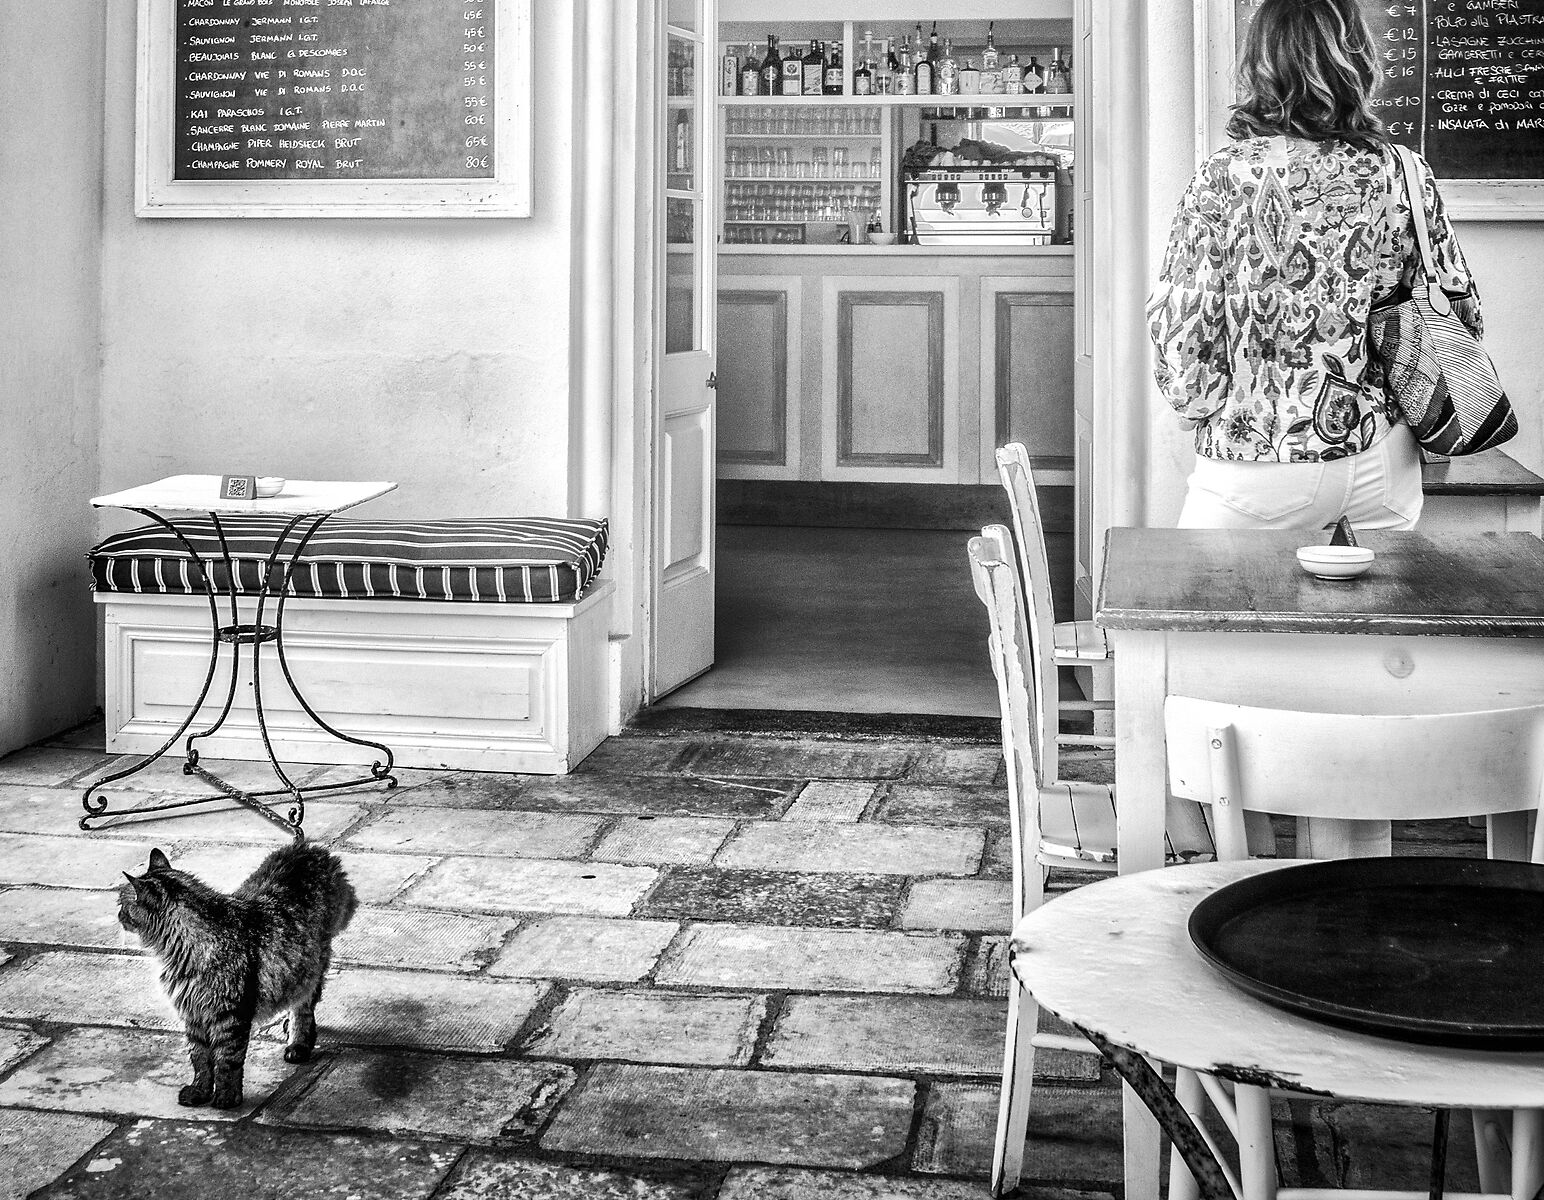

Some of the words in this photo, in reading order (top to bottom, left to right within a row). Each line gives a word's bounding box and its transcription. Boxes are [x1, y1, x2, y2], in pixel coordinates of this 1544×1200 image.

[1466, 0, 1519, 10] GAMBERI
[188, 18, 240, 26] CHARDONNAY
[252, 16, 292, 26] JERMANN
[1435, 15, 1467, 28] POLPO
[1470, 15, 1490, 28] alla
[189, 36, 236, 46] SAUVIGNON
[250, 33, 293, 44] JERMANN
[1436, 36, 1490, 48] LASAGNE
[251, 51, 278, 61] BLANC
[1438, 48, 1502, 60] GAMBERETTI
[188, 70, 246, 82] CHARDONNAY
[254, 71, 270, 80] VIE
[278, 70, 286, 79] DI
[293, 69, 330, 78] ROMANS
[1488, 75, 1528, 84] FRITTE
[189, 90, 236, 100] SAUVIGNON
[254, 88, 268, 96] VIE
[278, 87, 286, 96] DI
[294, 86, 332, 94] ROMANS
[1437, 90, 1474, 100] CREMA
[1497, 90, 1520, 99] CECI
[190, 110, 208, 118] KAI
[190, 125, 234, 136] SANCERRE
[241, 124, 268, 132] BLANC
[274, 122, 310, 132] DOMAINE
[322, 120, 350, 129] PIERRE
[354, 118, 386, 128] MARTIN
[1438, 118, 1490, 130] INSALATA
[1517, 118, 1544, 130] MAR
[192, 142, 240, 152] CHAMPAGNE
[248, 138, 272, 148] PIPER
[279, 139, 326, 149] HEIDSIECK
[335, 138, 362, 149] BRUT
[192, 160, 240, 170] CHAMPAGNE
[246, 158, 286, 169] POMMERY
[296, 160, 324, 170] ROYAL
[336, 160, 364, 169] BRUT
